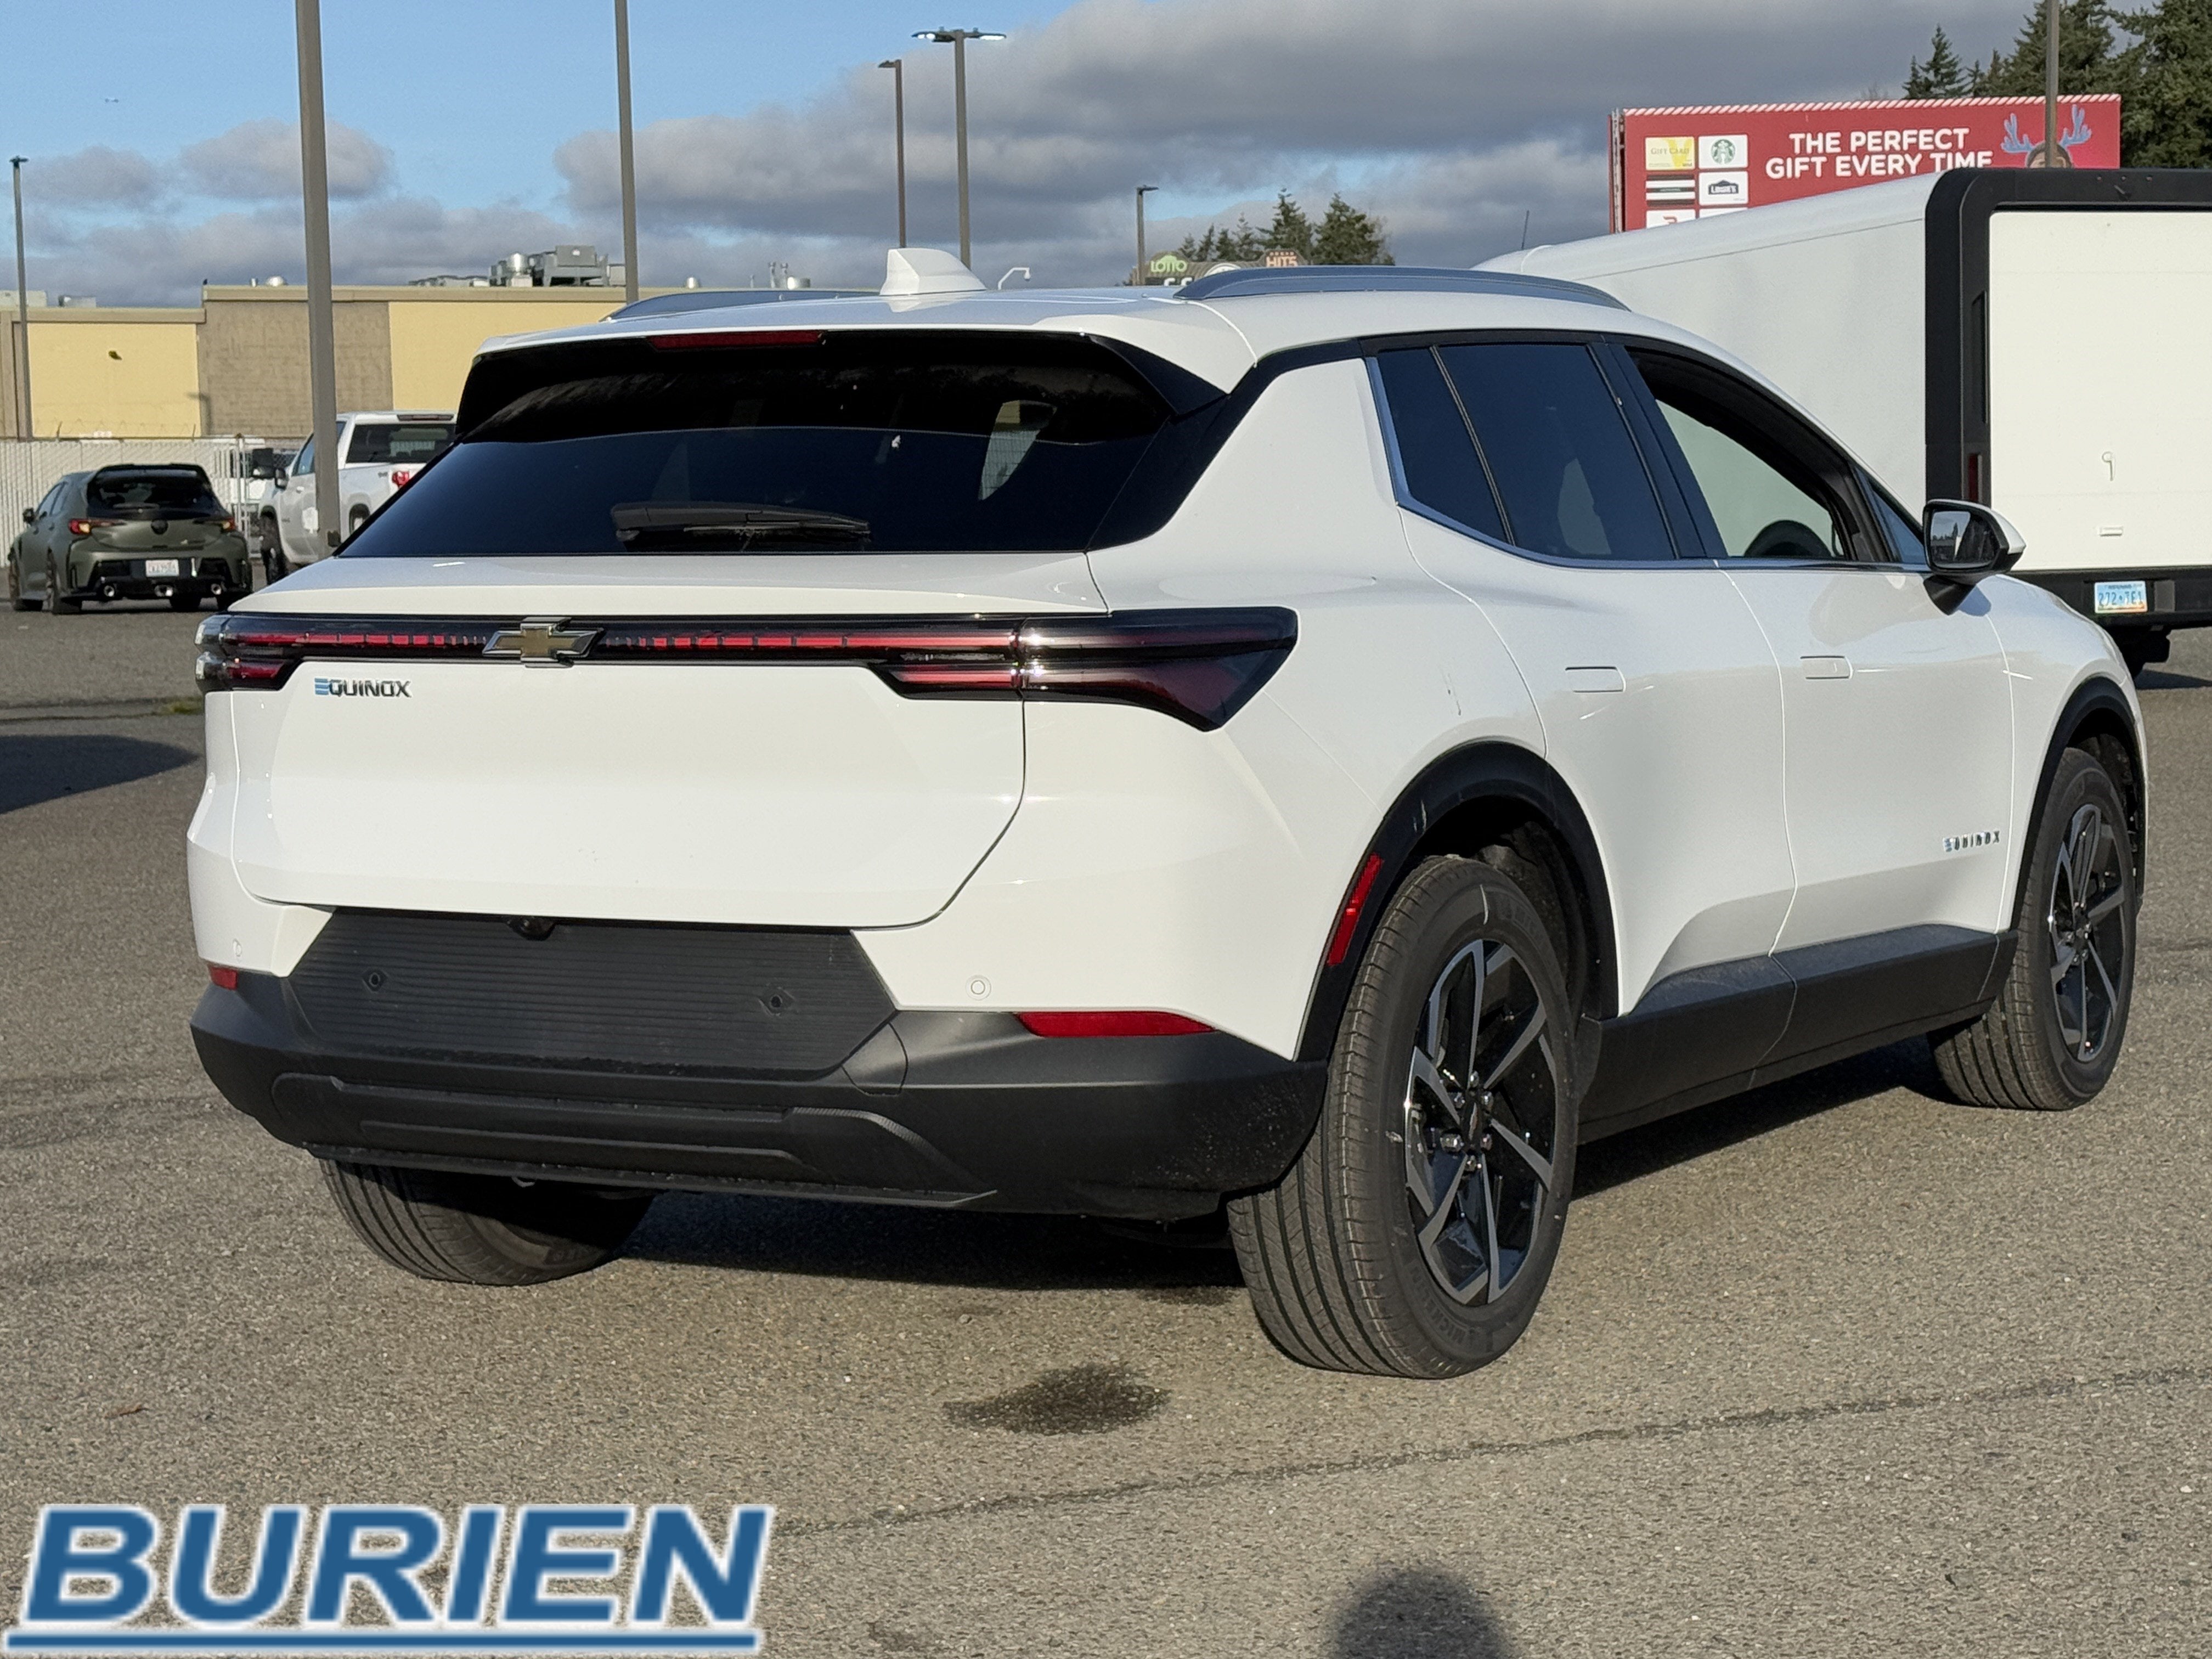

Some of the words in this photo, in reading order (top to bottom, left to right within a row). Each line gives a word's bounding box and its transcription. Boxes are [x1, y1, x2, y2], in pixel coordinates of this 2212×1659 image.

[1789, 132, 1842, 155] THE
[1850, 128, 1970, 153] PERFECT
[1765, 156, 1827, 179] GIFT
[1835, 154, 1923, 177] EVERY
[1929, 150, 1994, 174] TIME
[314, 678, 411, 697] EQUINOX
[1944, 830, 2000, 852] EQUINOX
